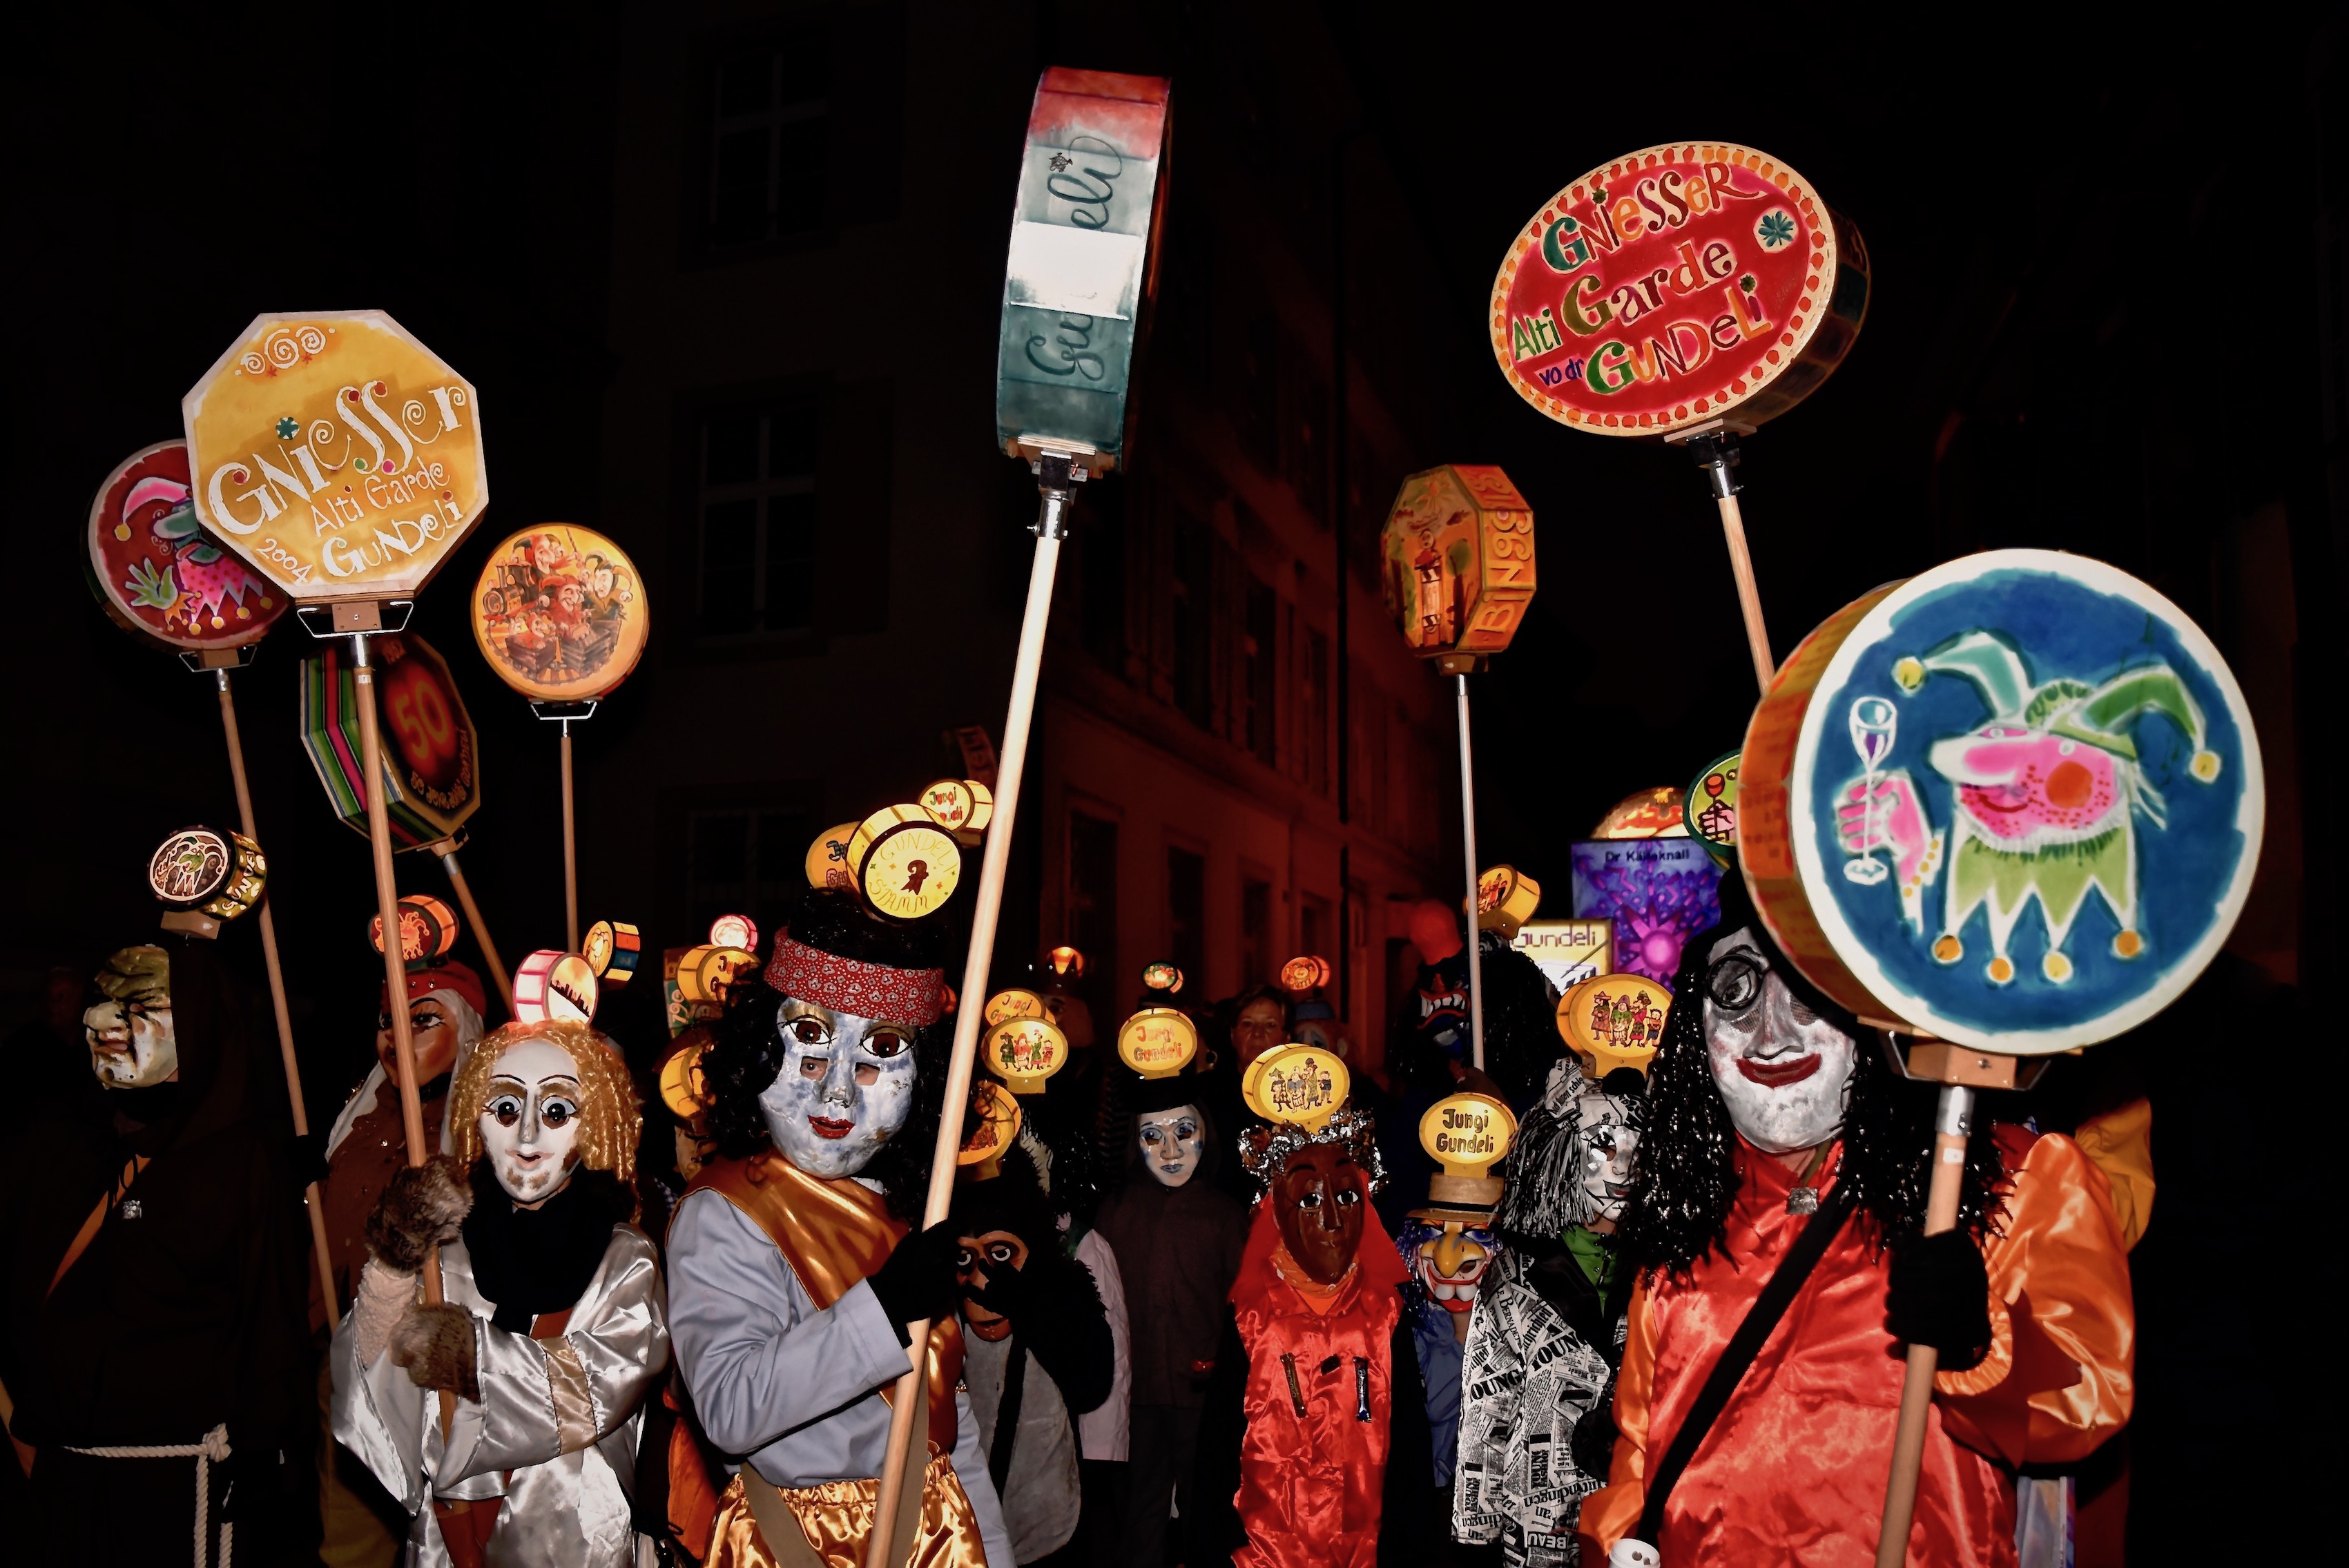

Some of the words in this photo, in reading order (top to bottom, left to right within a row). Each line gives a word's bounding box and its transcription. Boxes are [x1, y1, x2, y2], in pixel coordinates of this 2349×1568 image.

[1025, 136, 1123, 381] Gueli
[1514, 309, 1561, 361] Alti
[1562, 242, 1732, 335] Garde
[309, 485, 365, 537] Alti
[364, 456, 451, 510] Garde
[256, 538, 311, 584] 2004
[394, 680, 450, 760] 50
[929, 786, 957, 806] Jungi
[939, 805, 963, 822] ndeli
[880, 832, 959, 873] GUNDELI
[1605, 851, 1621, 862] Dr
[869, 878, 930, 913] STAMM
[1002, 994, 1034, 1014] Jungi
[1133, 1042, 1183, 1062] Gundeli
[1442, 1108, 1489, 1134] Jungi
[1436, 1132, 1494, 1154] Gundeli
[1528, 1533, 1567, 1549] BEAU
